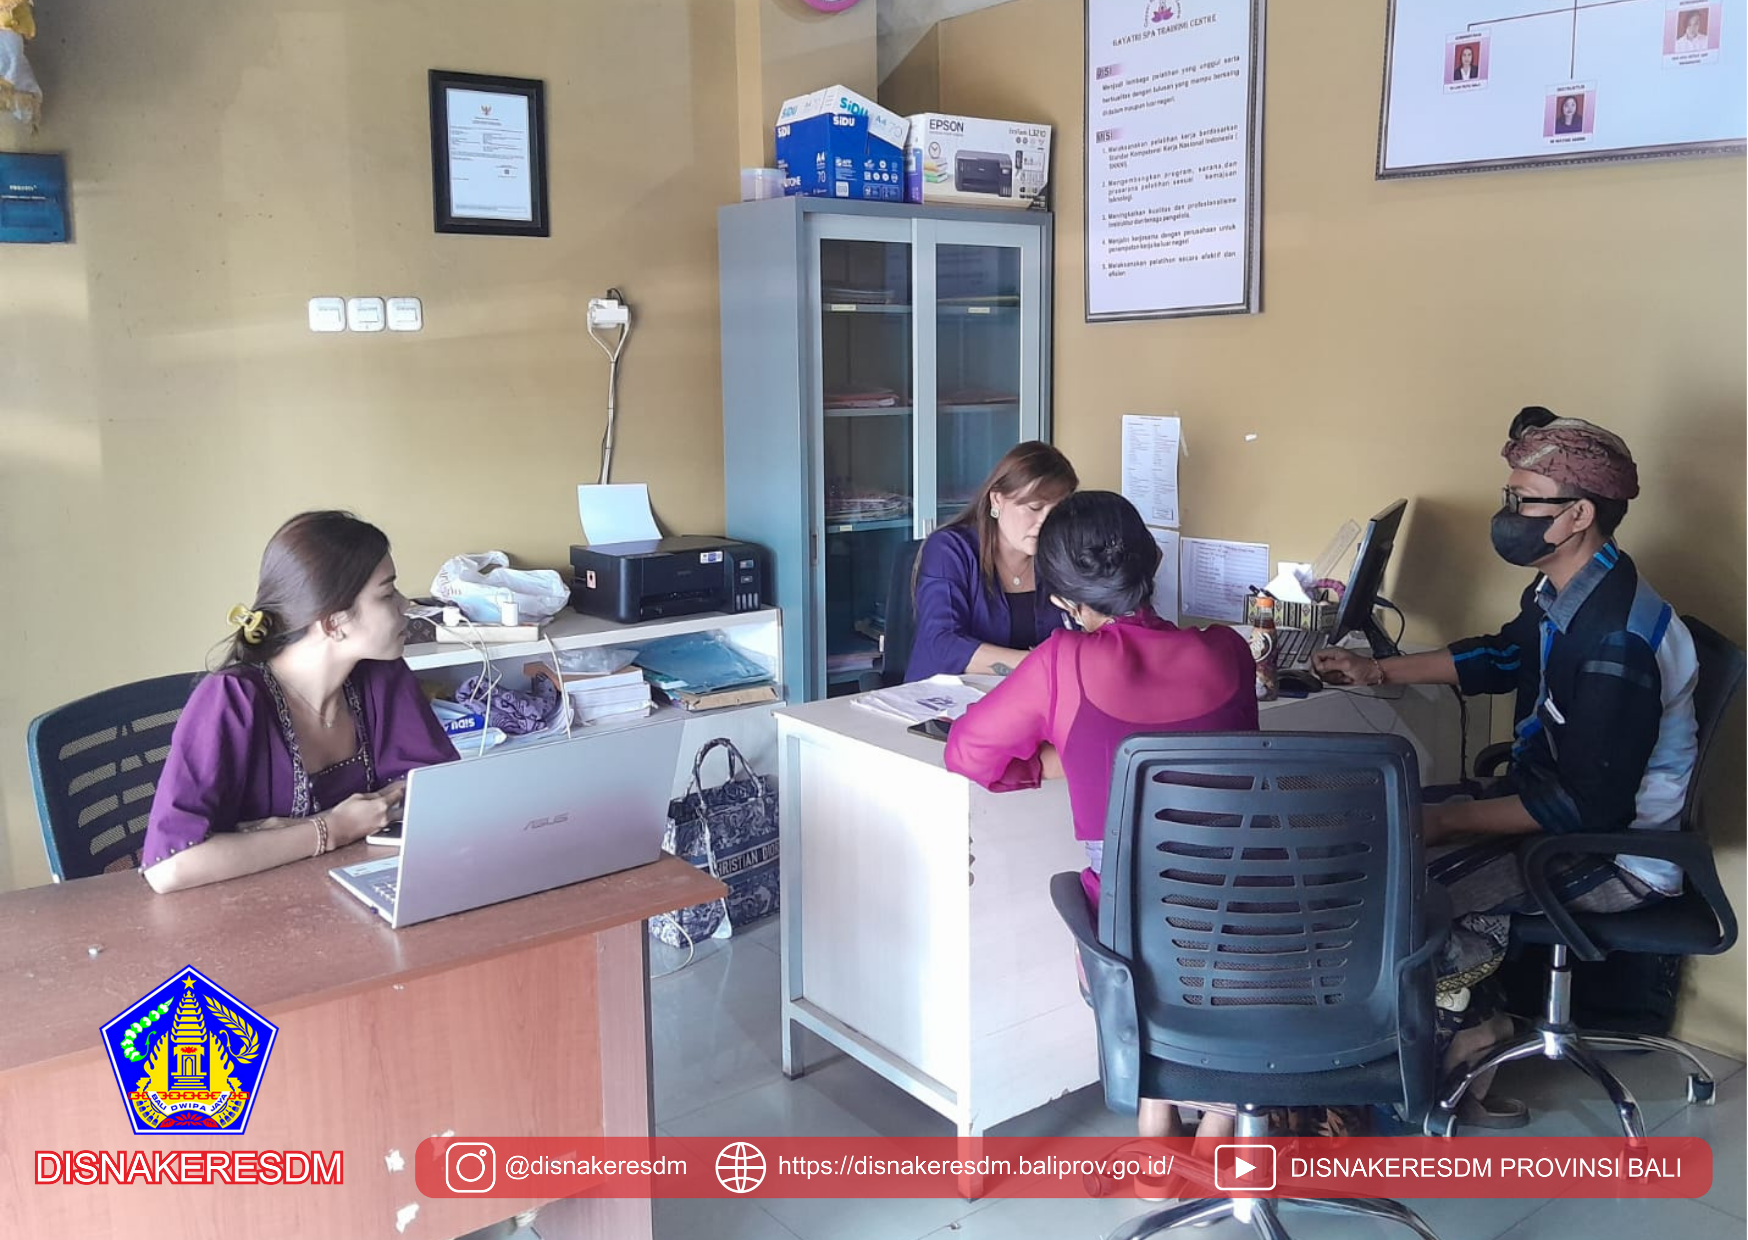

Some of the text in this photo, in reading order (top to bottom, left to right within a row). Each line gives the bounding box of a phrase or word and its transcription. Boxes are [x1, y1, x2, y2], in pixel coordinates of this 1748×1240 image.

[1143, 28, 1156, 38] SPA
[833, 116, 856, 126] SiDU
[929, 118, 964, 132] EPSON
[524, 811, 569, 831] ASUS
